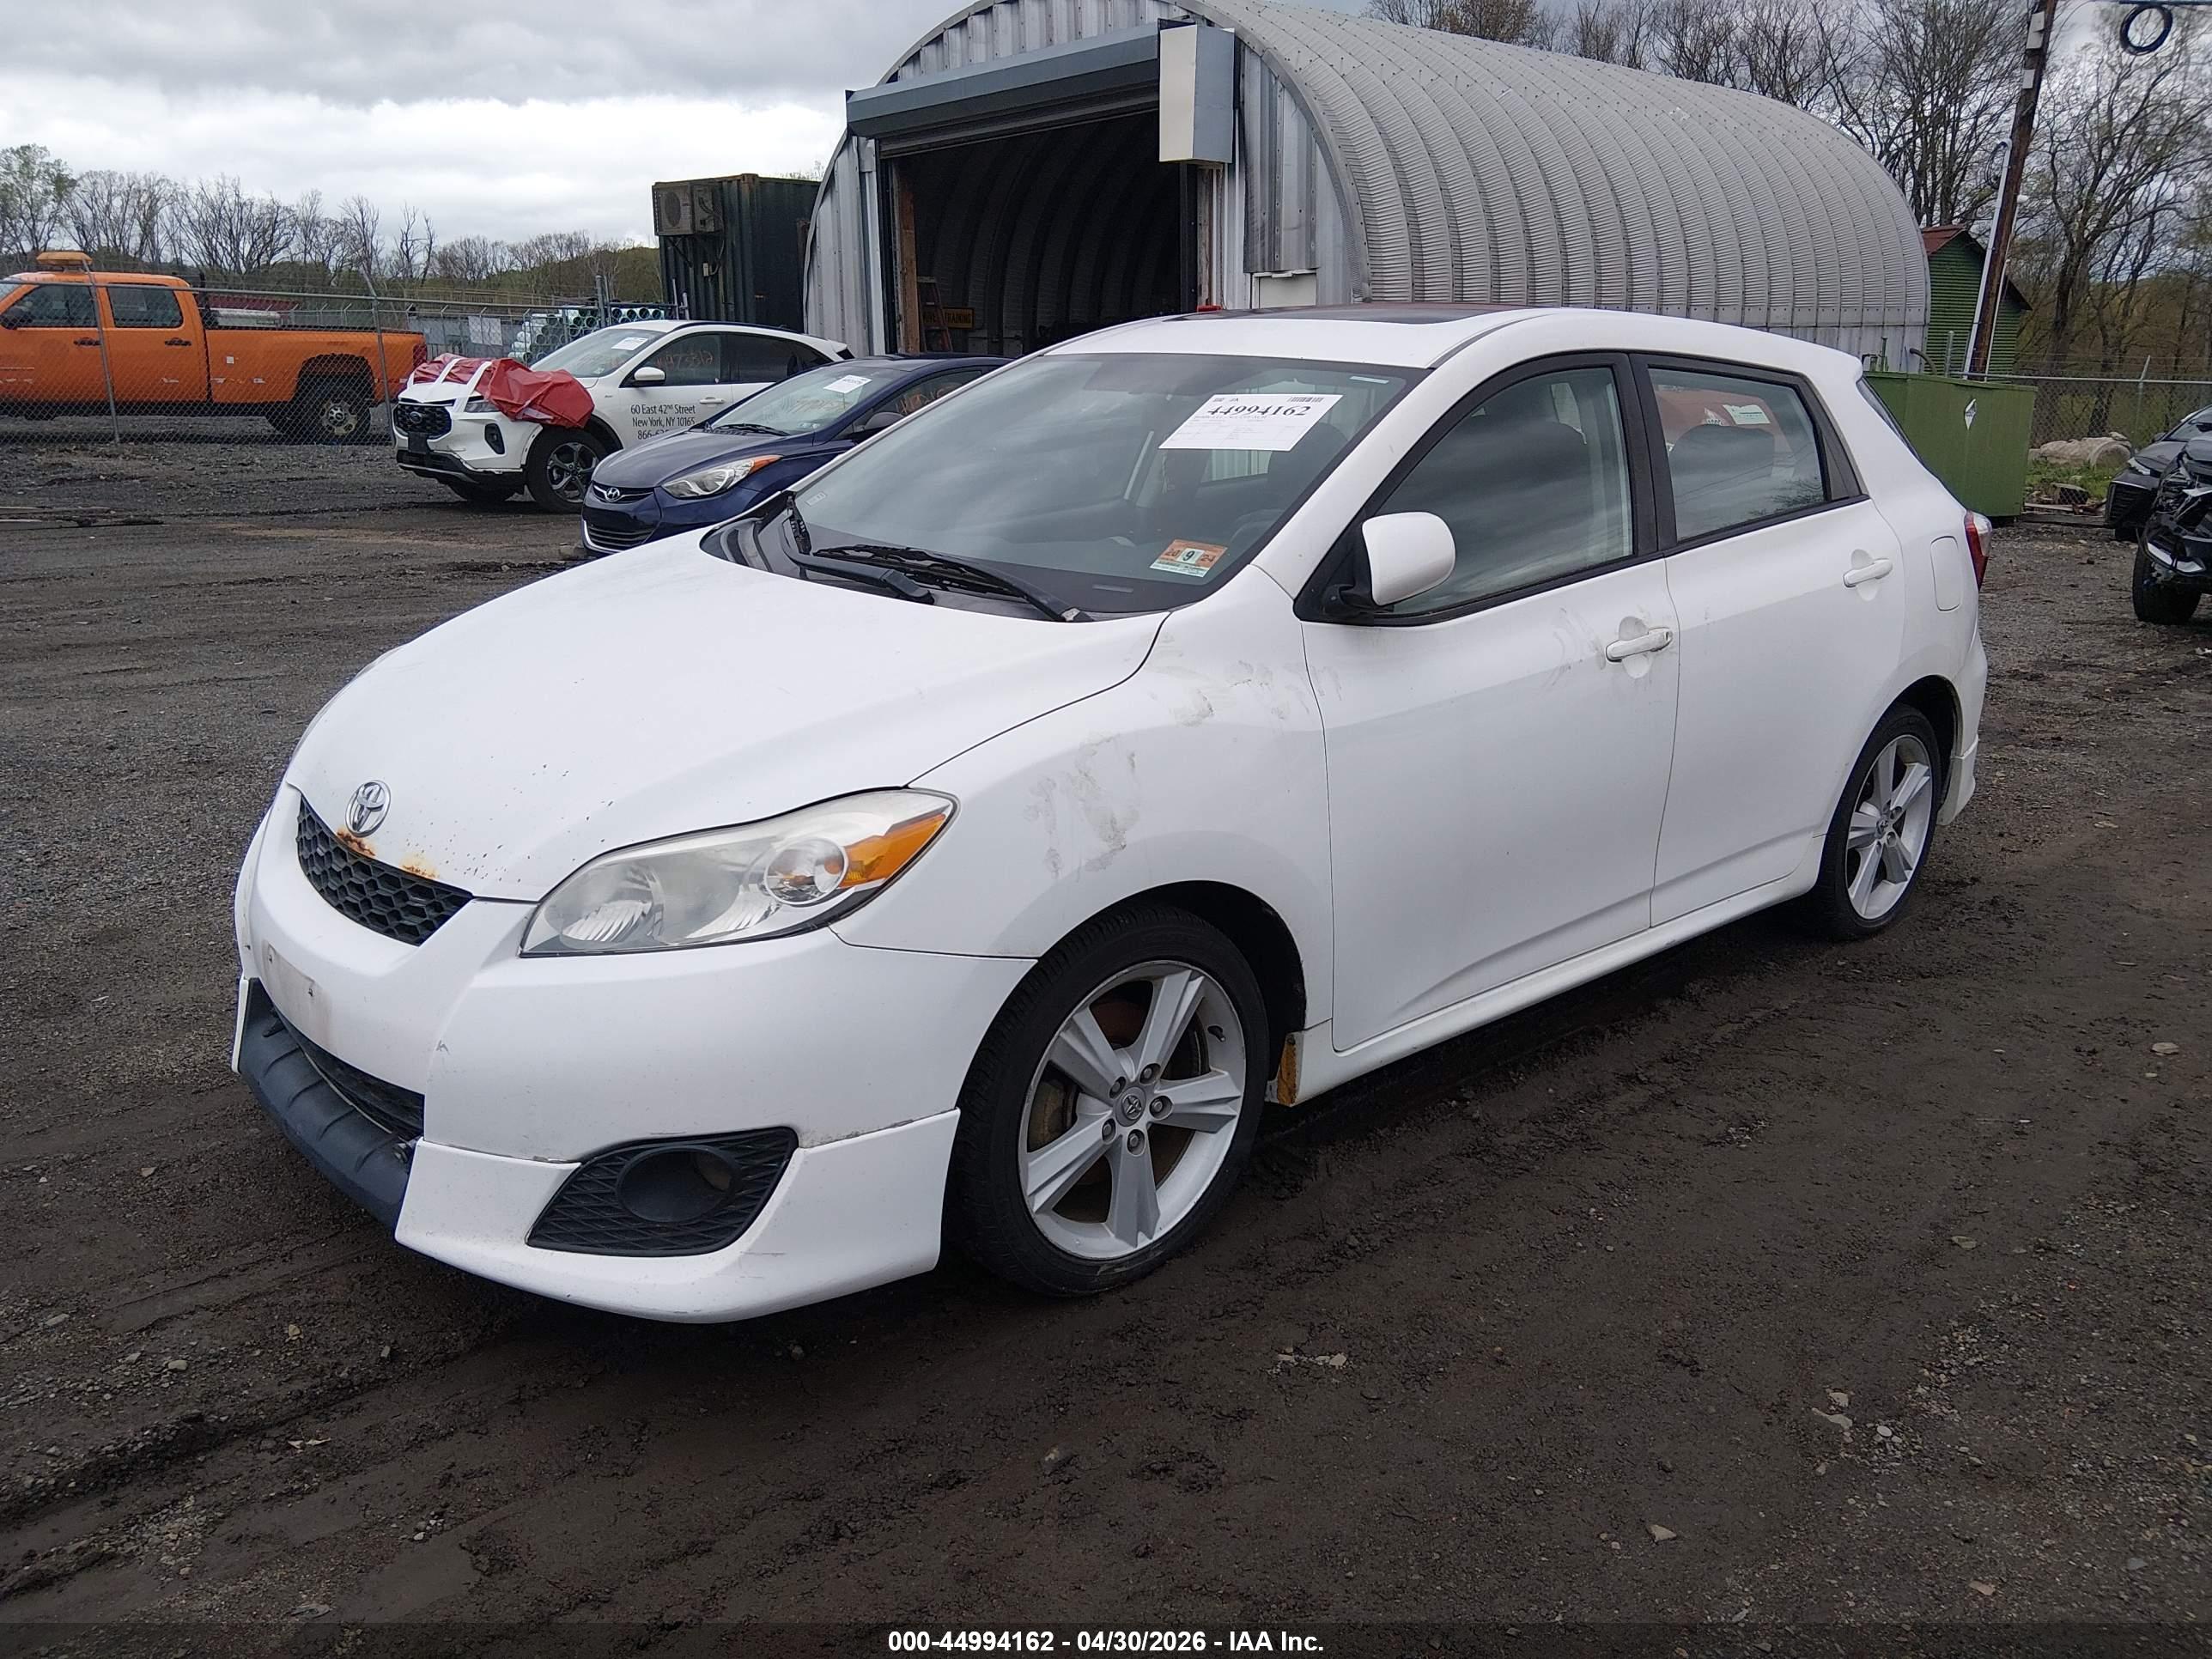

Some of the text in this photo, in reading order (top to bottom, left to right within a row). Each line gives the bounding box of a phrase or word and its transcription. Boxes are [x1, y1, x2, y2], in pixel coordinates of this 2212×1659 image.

[630, 404, 641, 415] 60
[641, 404, 657, 414] East
[674, 404, 696, 414] Street
[1207, 405, 1311, 416] 44994162
[632, 417, 696, 428] New York, NY 10165
[1182, 550, 1195, 562] 9
